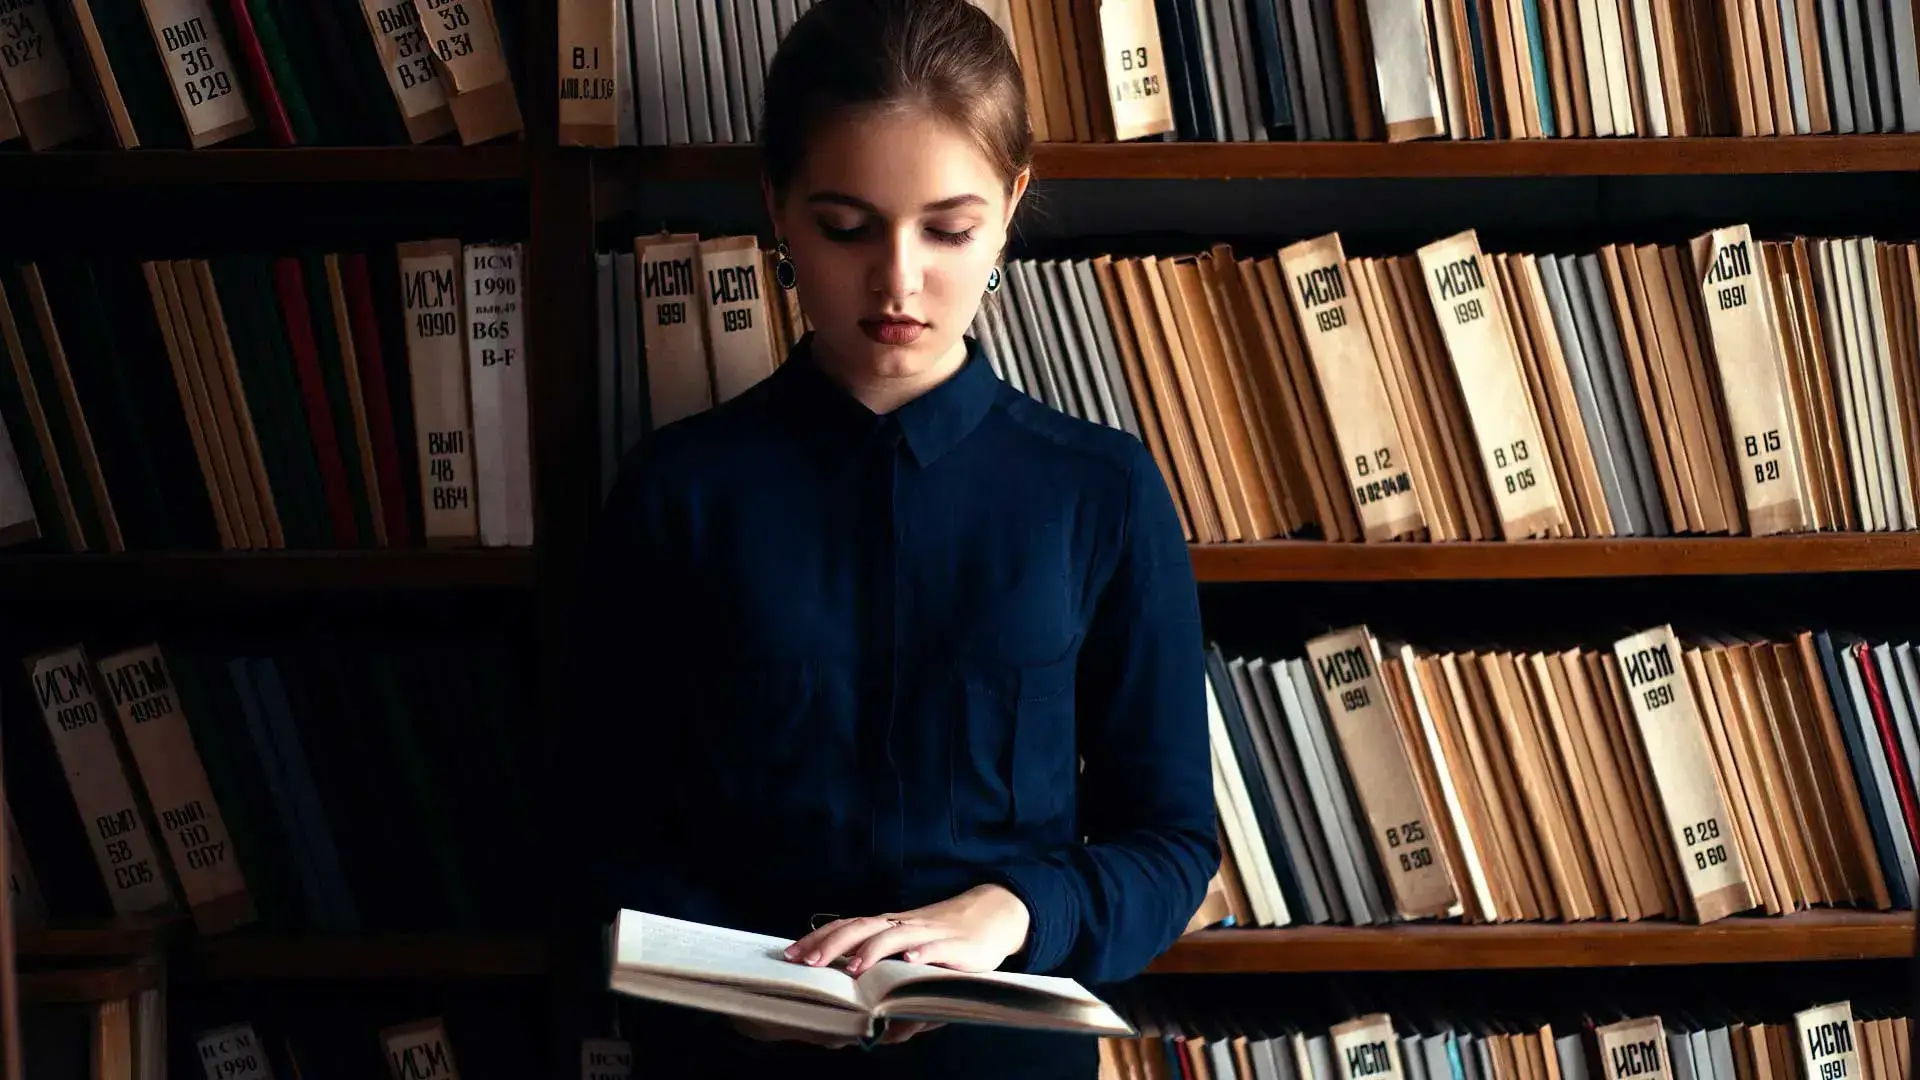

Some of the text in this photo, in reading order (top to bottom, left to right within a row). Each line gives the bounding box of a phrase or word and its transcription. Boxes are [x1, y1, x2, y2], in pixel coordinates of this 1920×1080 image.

[438, 4, 469, 30] 38
[162, 17, 207, 51] ВЫП
[395, 27, 423, 57] 37
[181, 46, 214, 75] 36
[475, 256, 512, 270] ИСМ
[405, 269, 455, 309] ИСМ
[475, 278, 516, 296] 1990
[644, 258, 694, 298] ИСМ
[709, 265, 759, 305] ИСМ
[1296, 263, 1347, 309] ИСМ
[1435, 255, 1485, 301] ИСМ
[1454, 298, 1485, 324] 1991
[1718, 285, 1747, 310] 1991
[417, 312, 456, 338] 1990
[657, 302, 686, 326] 1991
[722, 308, 753, 332] 1991
[1316, 305, 1347, 332] 1991
[428, 431, 464, 454] ВЫП
[431, 459, 454, 481] 48
[1318, 646, 1370, 690] ИСМ
[1624, 643, 1674, 687] ИСМ
[34, 662, 92, 709] ИСМ
[106, 657, 168, 706] ИСМ
[128, 694, 172, 723] 1990
[1340, 686, 1371, 713] 1991
[1643, 683, 1675, 710] 1991
[57, 702, 97, 731] 1990
[163, 800, 206, 831] ВЫП
[1807, 1020, 1853, 1060] ИСМ
[216, 1055, 257, 1080] 1990
[393, 1041, 450, 1080] ИСМ
[1346, 1041, 1391, 1078] ИСМ
[1612, 1040, 1660, 1079] ИСМ
[1820, 1058, 1848, 1080] 1991
